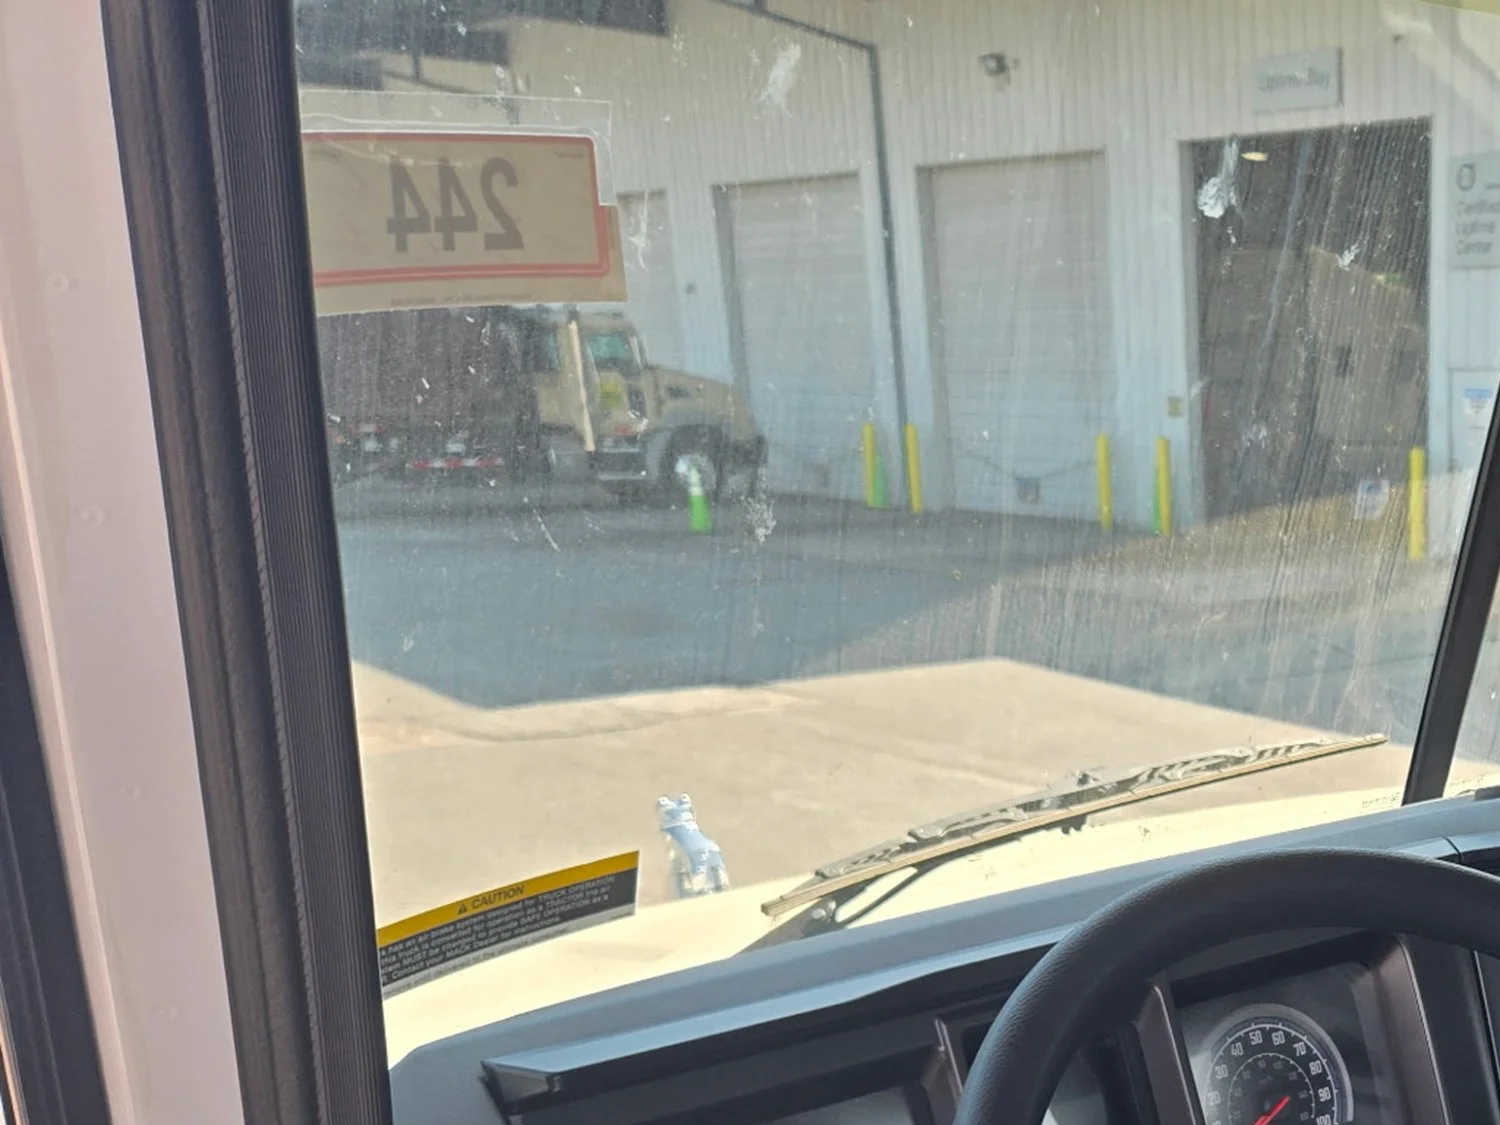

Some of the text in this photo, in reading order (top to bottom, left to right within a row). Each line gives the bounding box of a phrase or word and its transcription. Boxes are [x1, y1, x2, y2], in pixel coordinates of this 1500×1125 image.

[472, 884, 525, 910] CAUTION
[1249, 1031, 1263, 1045] 50
[1271, 1031, 1285, 1045] 60
[1231, 1042, 1244, 1056] 40
[1293, 1042, 1306, 1056] 70
[1215, 1064, 1229, 1079] 30
[1309, 1060, 1322, 1075] 80
[1207, 1091, 1221, 1106] 20
[1318, 1087, 1331, 1102] 90
